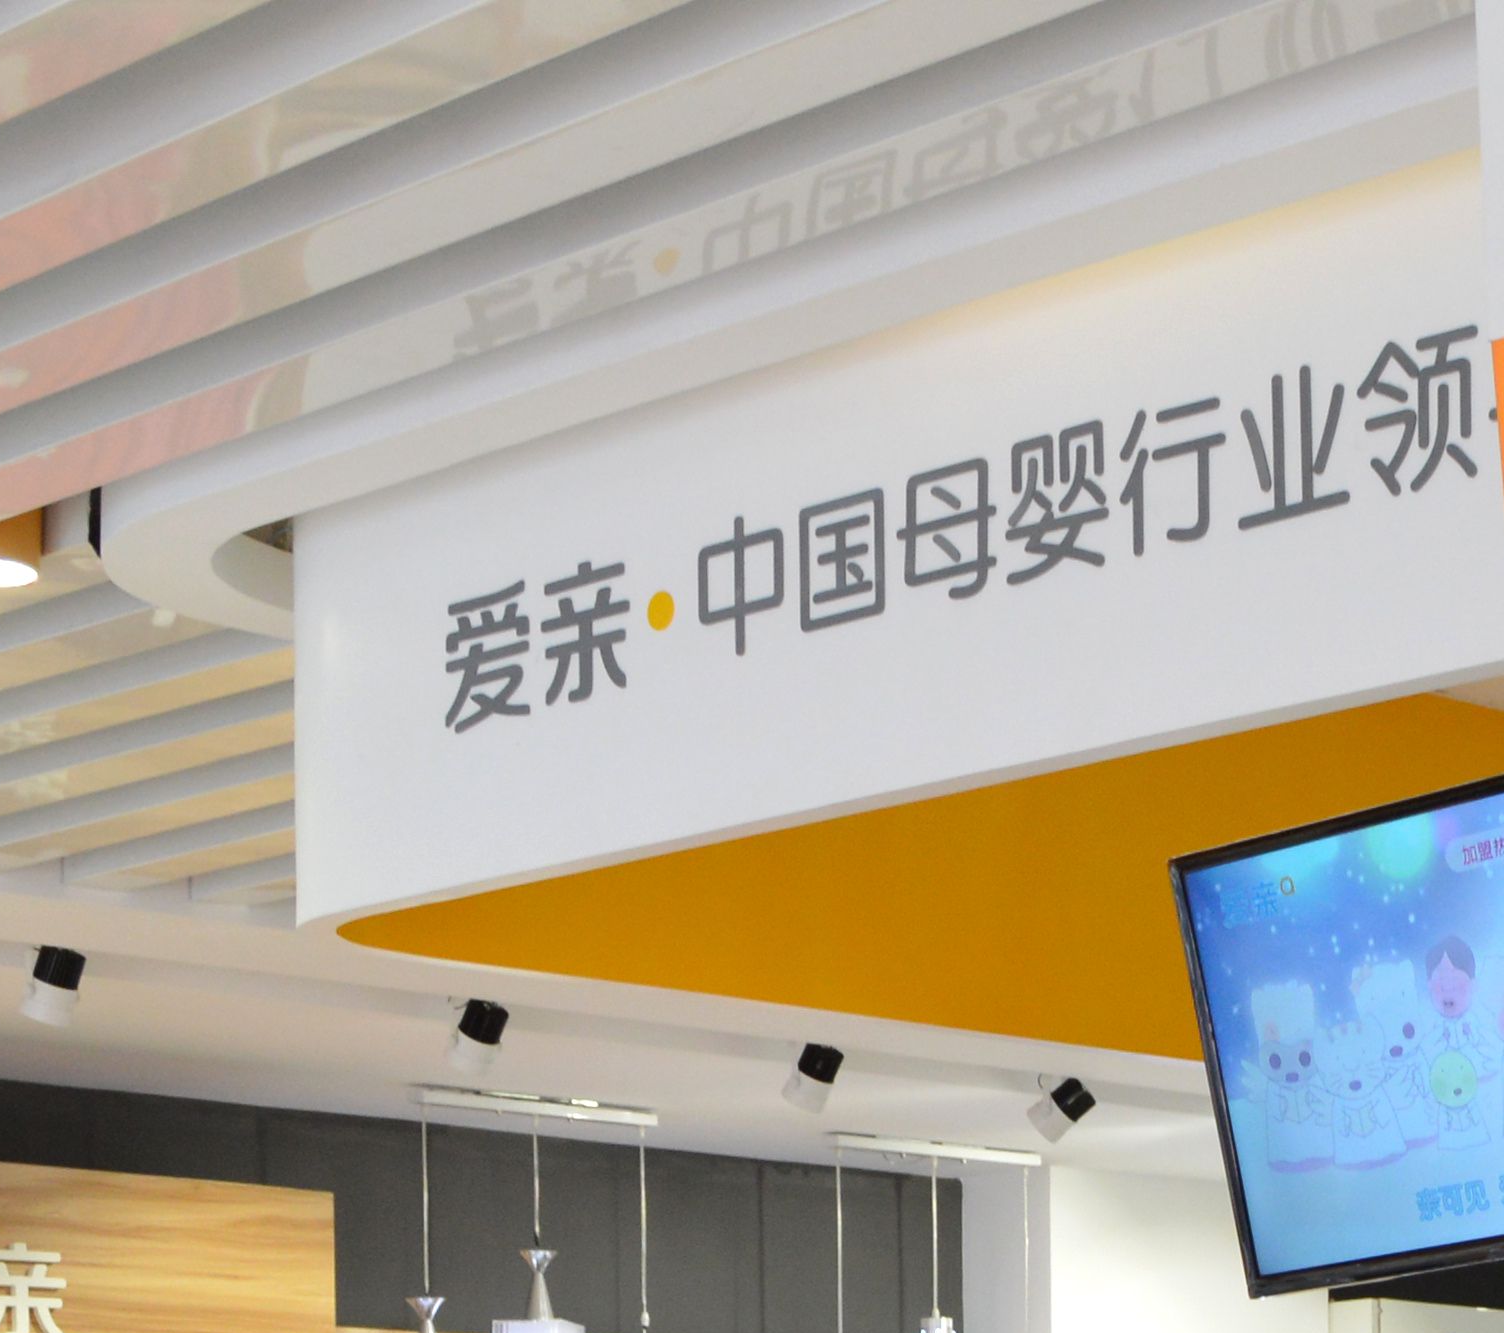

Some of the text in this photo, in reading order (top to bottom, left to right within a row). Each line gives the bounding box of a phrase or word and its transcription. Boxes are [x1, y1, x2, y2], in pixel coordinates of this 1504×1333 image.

[441, 325, 1494, 736] 爱亲·中国母婴行业领
